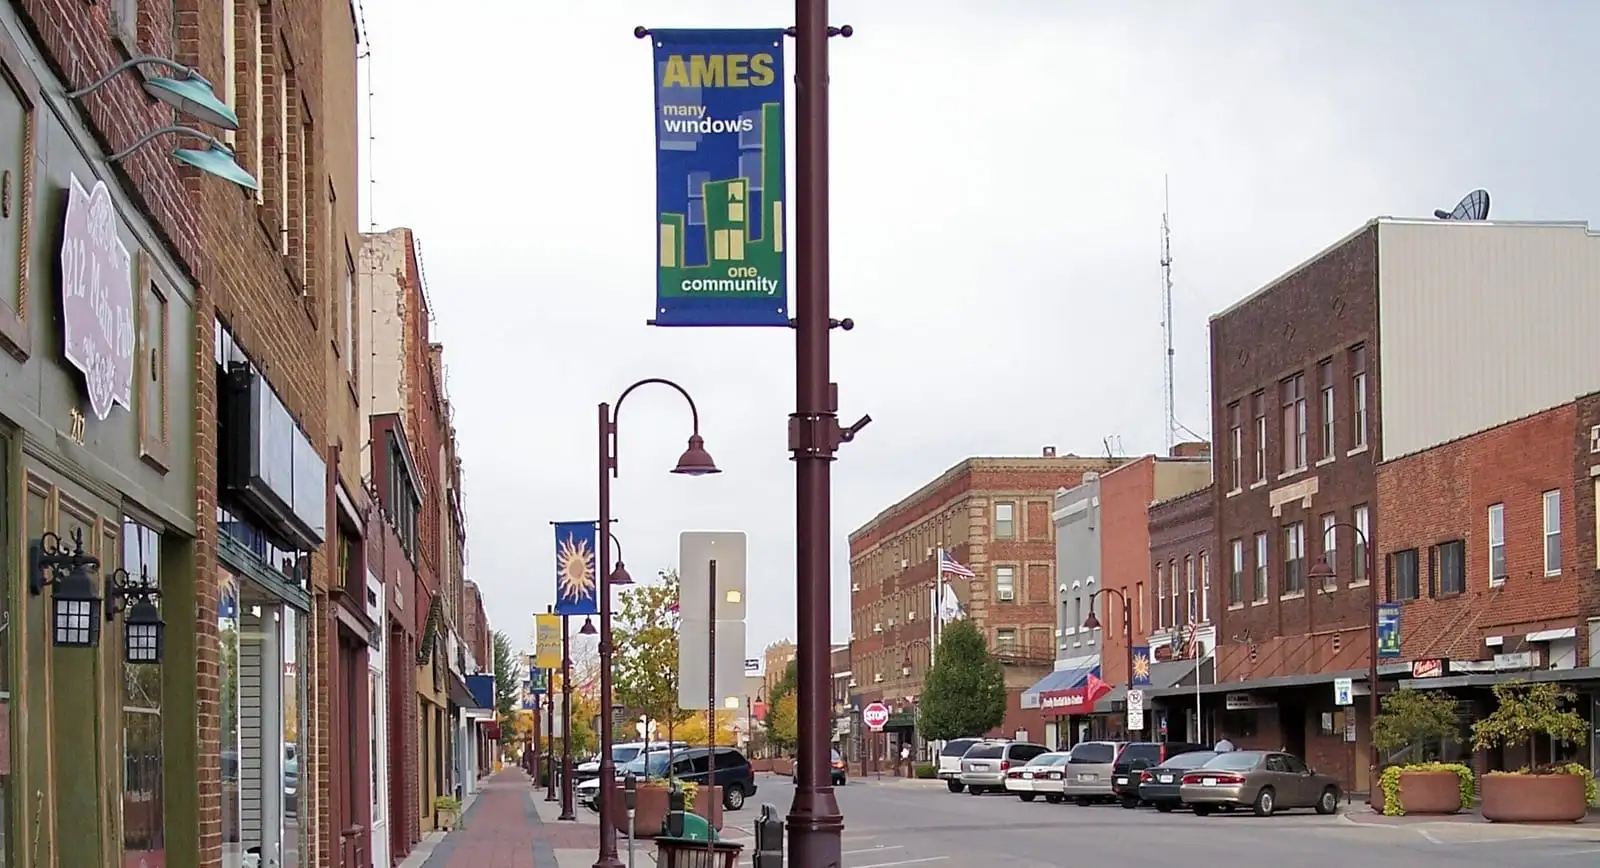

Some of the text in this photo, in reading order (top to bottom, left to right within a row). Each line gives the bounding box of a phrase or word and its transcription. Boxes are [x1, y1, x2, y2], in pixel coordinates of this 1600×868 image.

[662, 53, 775, 88] AMES
[663, 104, 706, 119] many
[664, 117, 753, 133] windows
[727, 266, 758, 278] one
[681, 276, 778, 295] community
[65, 236, 86, 298] 212
[90, 251, 113, 350] Main
[116, 305, 132, 358] Pub
[866, 710, 887, 721] STOP
